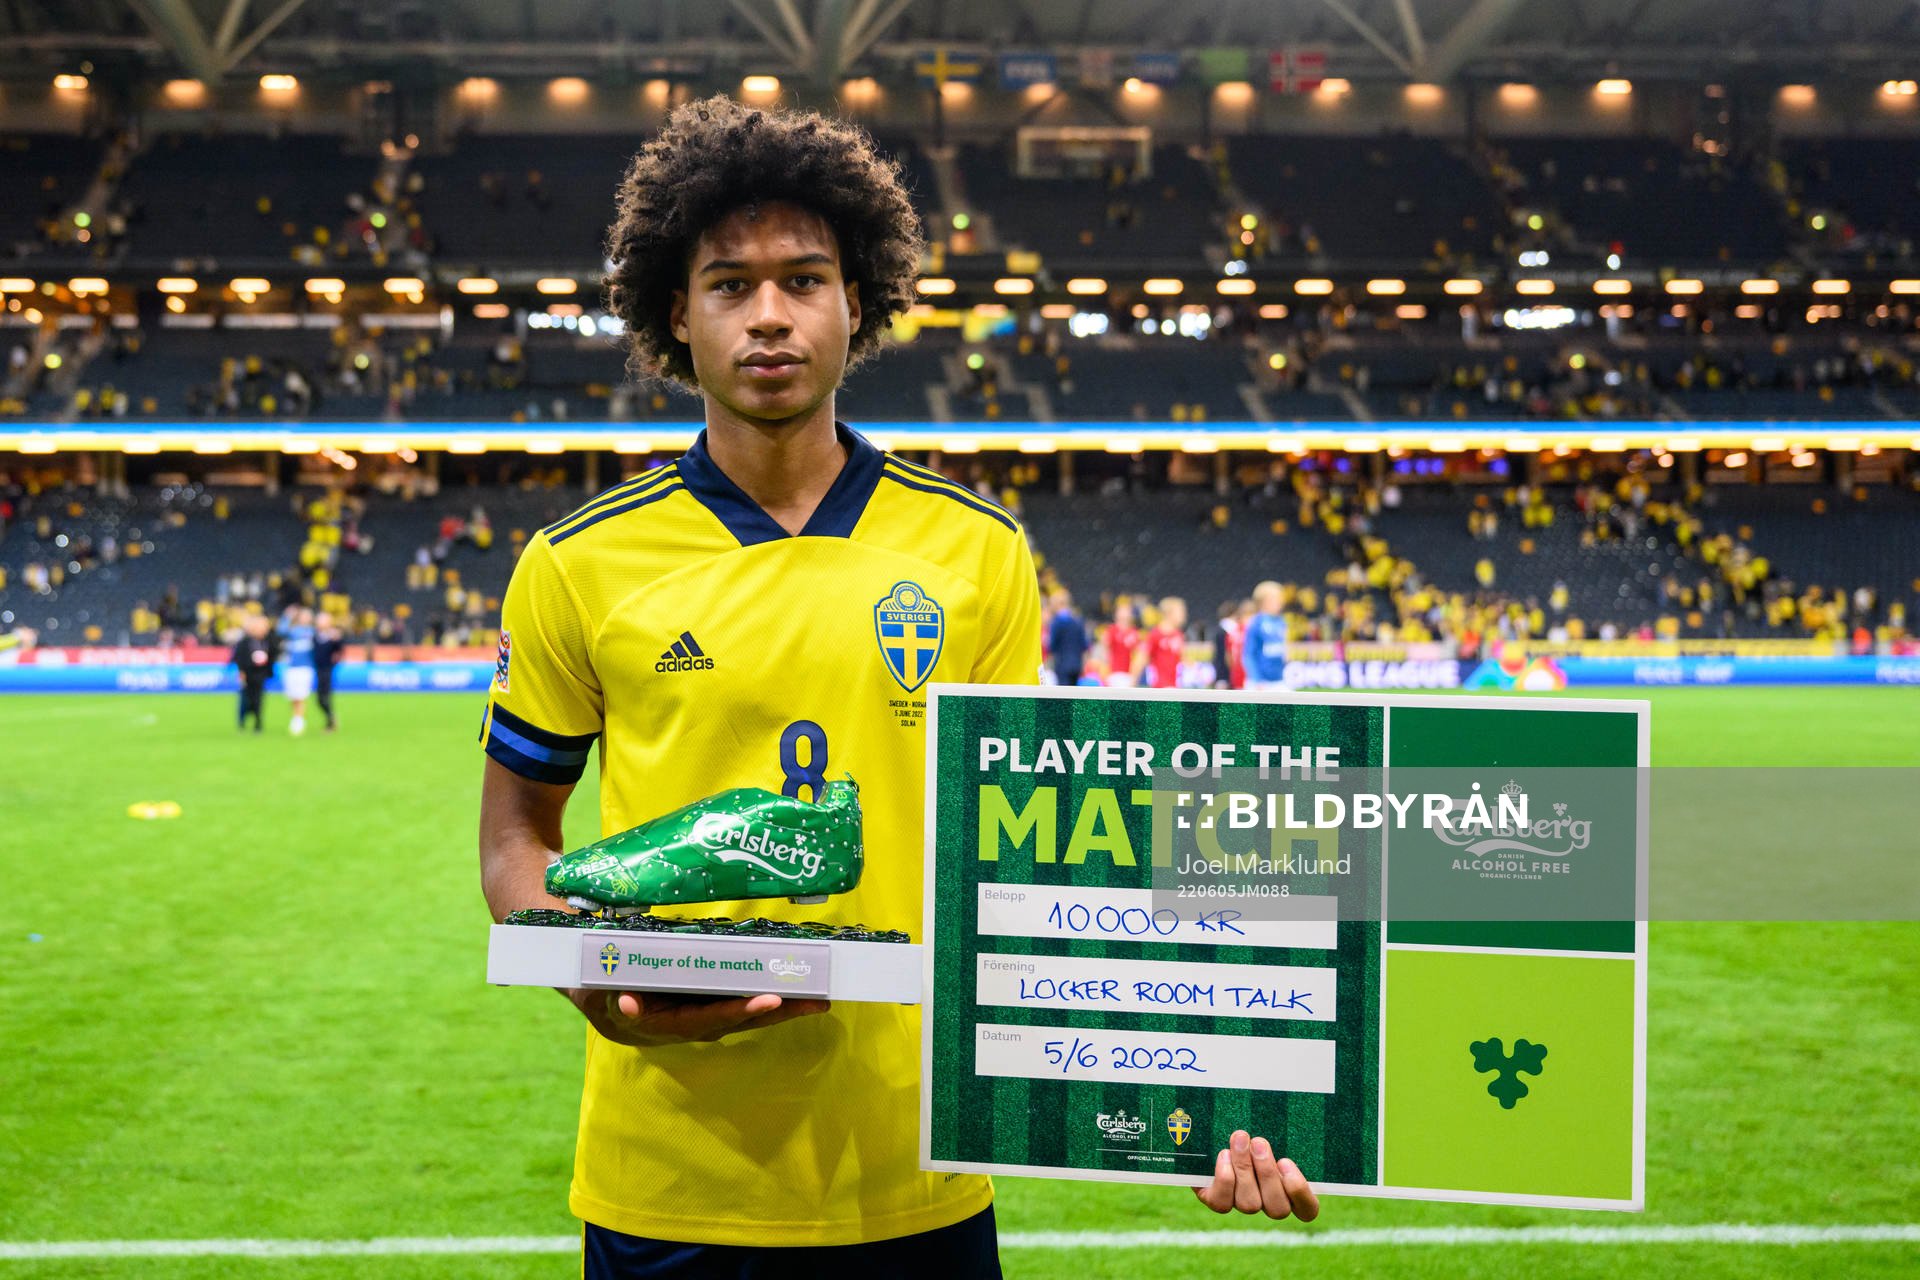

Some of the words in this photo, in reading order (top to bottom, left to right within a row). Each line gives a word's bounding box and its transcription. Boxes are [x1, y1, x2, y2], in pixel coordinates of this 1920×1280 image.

[886, 613, 932, 622] SVERIGE
[655, 656, 715, 673] adidas
[1349, 660, 1461, 689] LEAGUE
[780, 720, 828, 803] 8
[979, 736, 1155, 777] PLAYER
[1171, 742, 1236, 779] OF
[1250, 744, 1341, 782] THE
[978, 784, 1339, 875] MATCH
[690, 813, 824, 879] Carlsberg
[1451, 859, 1527, 872] ALCOHOL
[1532, 862, 1571, 874] FREE
[984, 889, 1026, 901] Belopp
[1194, 909, 1245, 935] KR
[628, 953, 673, 971] Player
[676, 955, 692, 968] of
[694, 956, 716, 969] the
[719, 958, 764, 971] match
[983, 959, 1036, 973] Förening
[1020, 978, 1121, 1002] LOCKER
[1133, 981, 1214, 1007] ROOM
[1224, 987, 1313, 1014] TALK
[982, 1030, 1022, 1042] Datum
[1044, 1038, 1098, 1073] 5/6
[1111, 1047, 1207, 1072] 2022
[1096, 1112, 1146, 1134] Carlsberg
